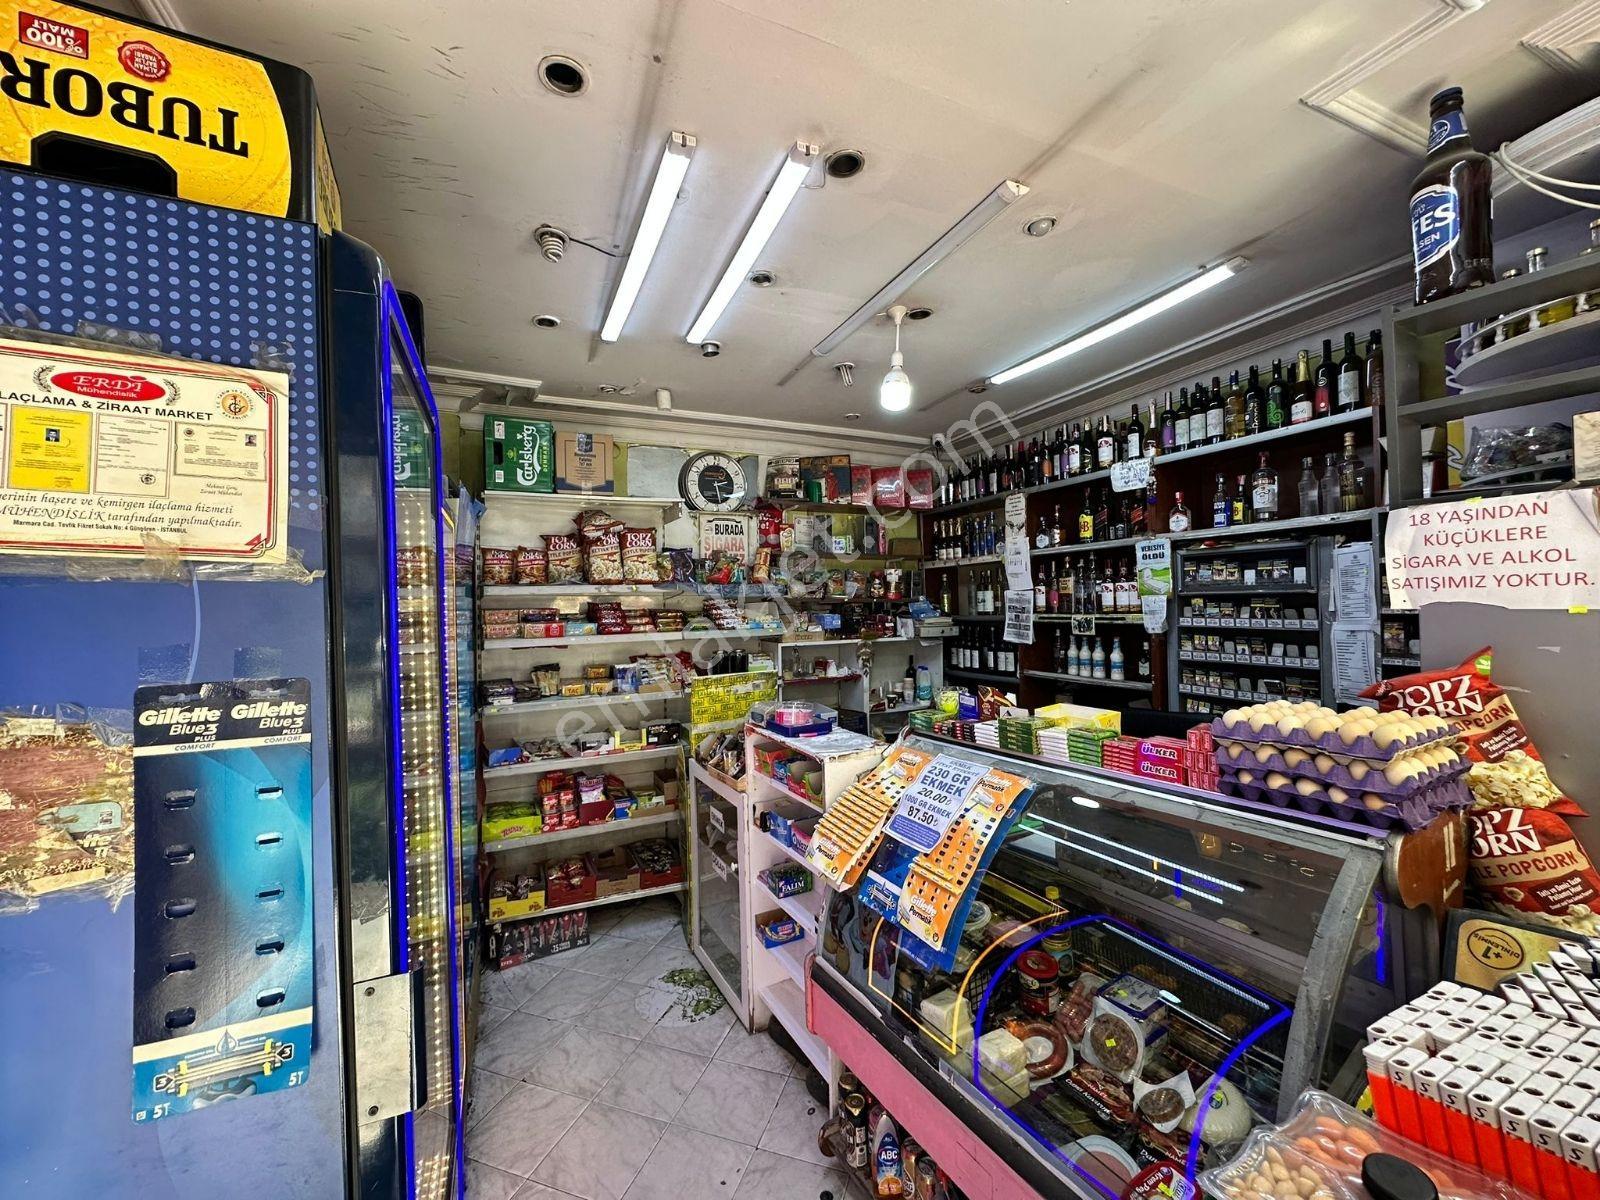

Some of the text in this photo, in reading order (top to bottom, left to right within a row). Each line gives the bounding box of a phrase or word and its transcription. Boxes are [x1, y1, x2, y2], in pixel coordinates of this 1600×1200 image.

[31, 18, 75, 37] MALT
[26, 27, 84, 56] %100
[81, 400, 92, 409] &
[97, 401, 151, 415] ZİRAAT
[155, 408, 213, 421] MARKET
[516, 425, 541, 485] Carlsberg
[40, 493, 77, 505] haşere
[97, 496, 145, 511] kemirgen
[148, 500, 192, 512] ilaçlama
[195, 502, 234, 514] hizmeti
[107, 511, 165, 525] tarafından
[1408, 501, 1548, 527] 18 YAŞINDAN
[625, 533, 653, 541] TOPZ
[713, 523, 745, 536] BURADA
[1423, 525, 1548, 548] KÜÇÜKLERE
[549, 542, 577, 551] CORN
[626, 539, 653, 549] CORN
[1141, 551, 1165, 561] ÖLDÜ
[1392, 548, 1576, 570] SİGARA VE ALKOL
[1391, 572, 1595, 592] SATIŞIMIZ YOKTUR.
[1388, 674, 1480, 709] TOPZ
[138, 701, 308, 727] Gillette Gillette
[1400, 692, 1484, 718] ORN
[168, 717, 304, 736] Blue3 Blue3
[174, 736, 302, 752] COMFORT COMFORT
[193, 734, 217, 743] PLUS
[1141, 741, 1178, 760] ÜLKER
[927, 765, 972, 786] 230 GR
[1141, 761, 1178, 779] ÜLKER
[920, 774, 966, 798] EKMEK
[917, 799, 930, 810] GR
[928, 803, 952, 819] EKMEK
[1469, 807, 1534, 837] OPZ
[1471, 828, 1542, 858] ORN
[1496, 850, 1579, 878] POPCORN
[910, 894, 938, 916] Gillette
[908, 905, 932, 926] Permatik
[288, 1070, 304, 1087] 5T
[152, 1102, 172, 1119] 5T
[880, 1150, 899, 1160] ABC
